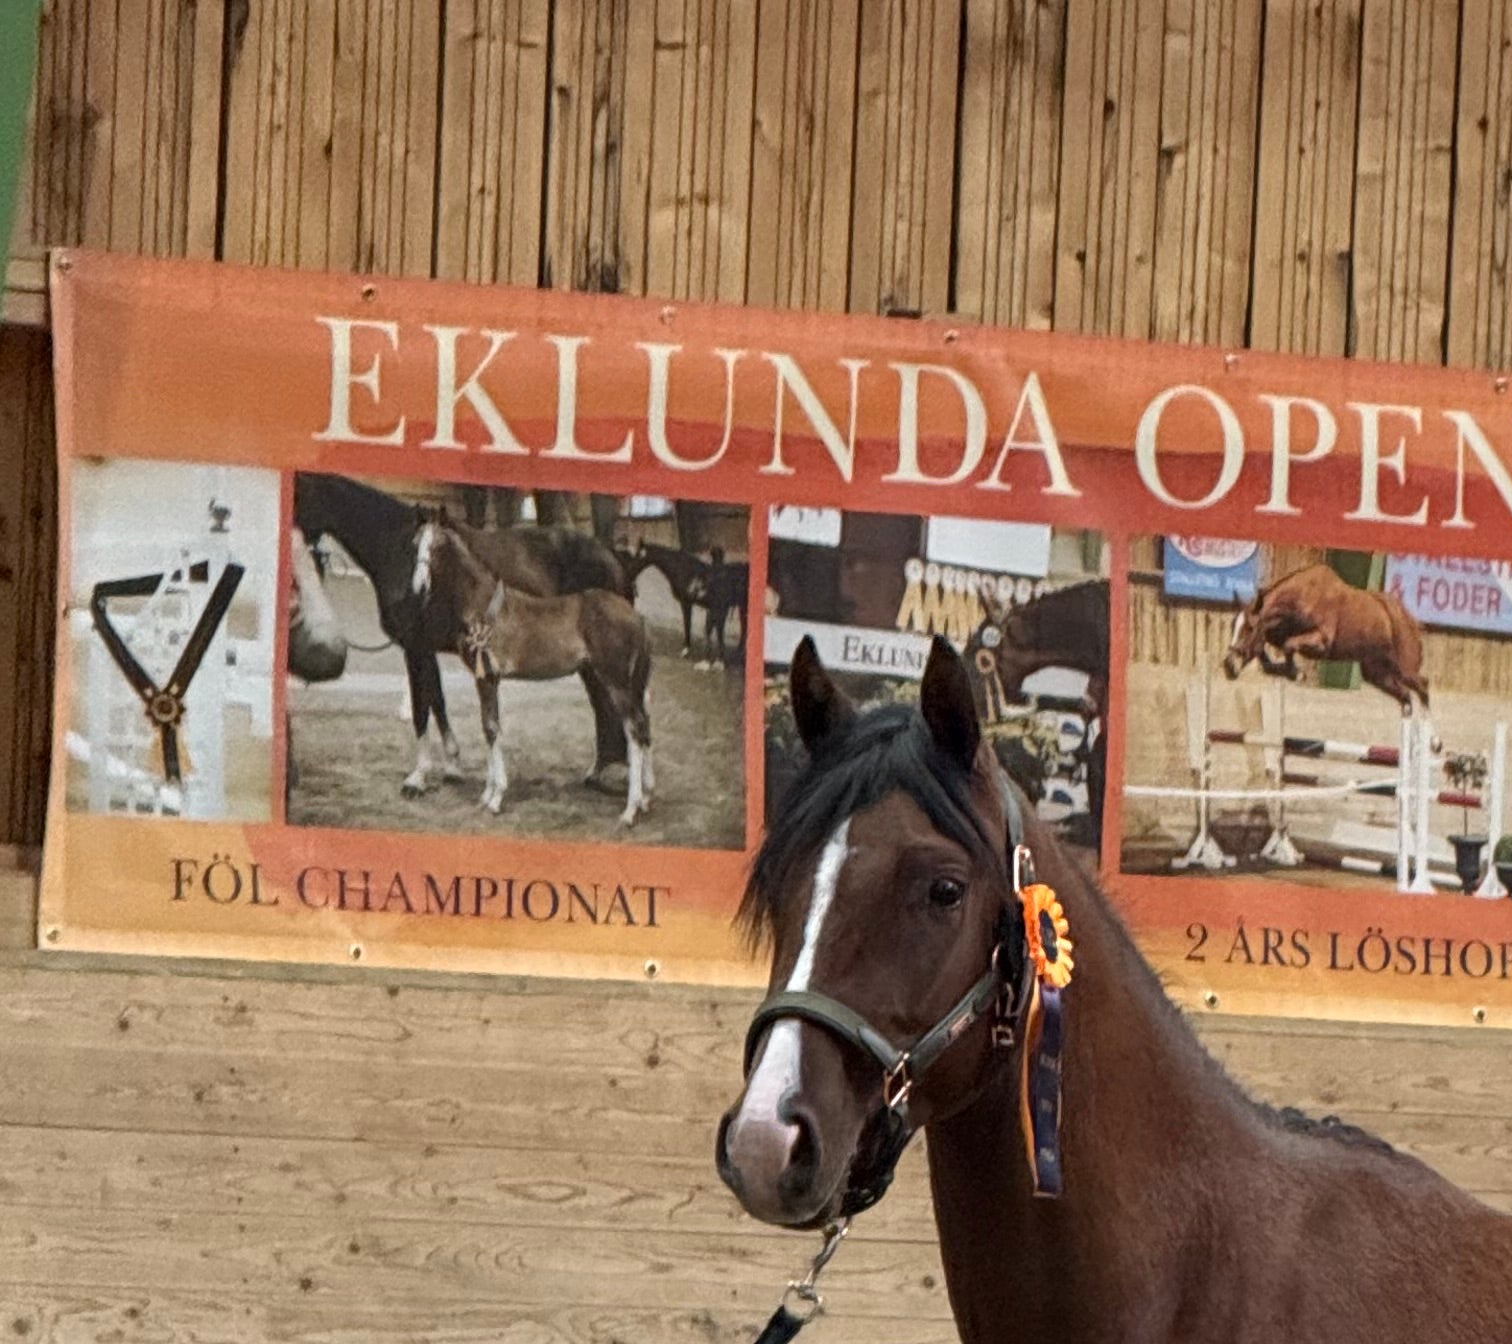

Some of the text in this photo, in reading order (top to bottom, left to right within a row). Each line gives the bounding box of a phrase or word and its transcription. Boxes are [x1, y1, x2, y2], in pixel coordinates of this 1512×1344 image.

[311, 316, 1082, 497] EKLUNDA
[1416, 575, 1502, 617] FODER
[169, 853, 672, 928] FÖL CHAMPIONAT
[1185, 922, 1207, 964] 2
[1225, 916, 1311, 969] ÅRS
